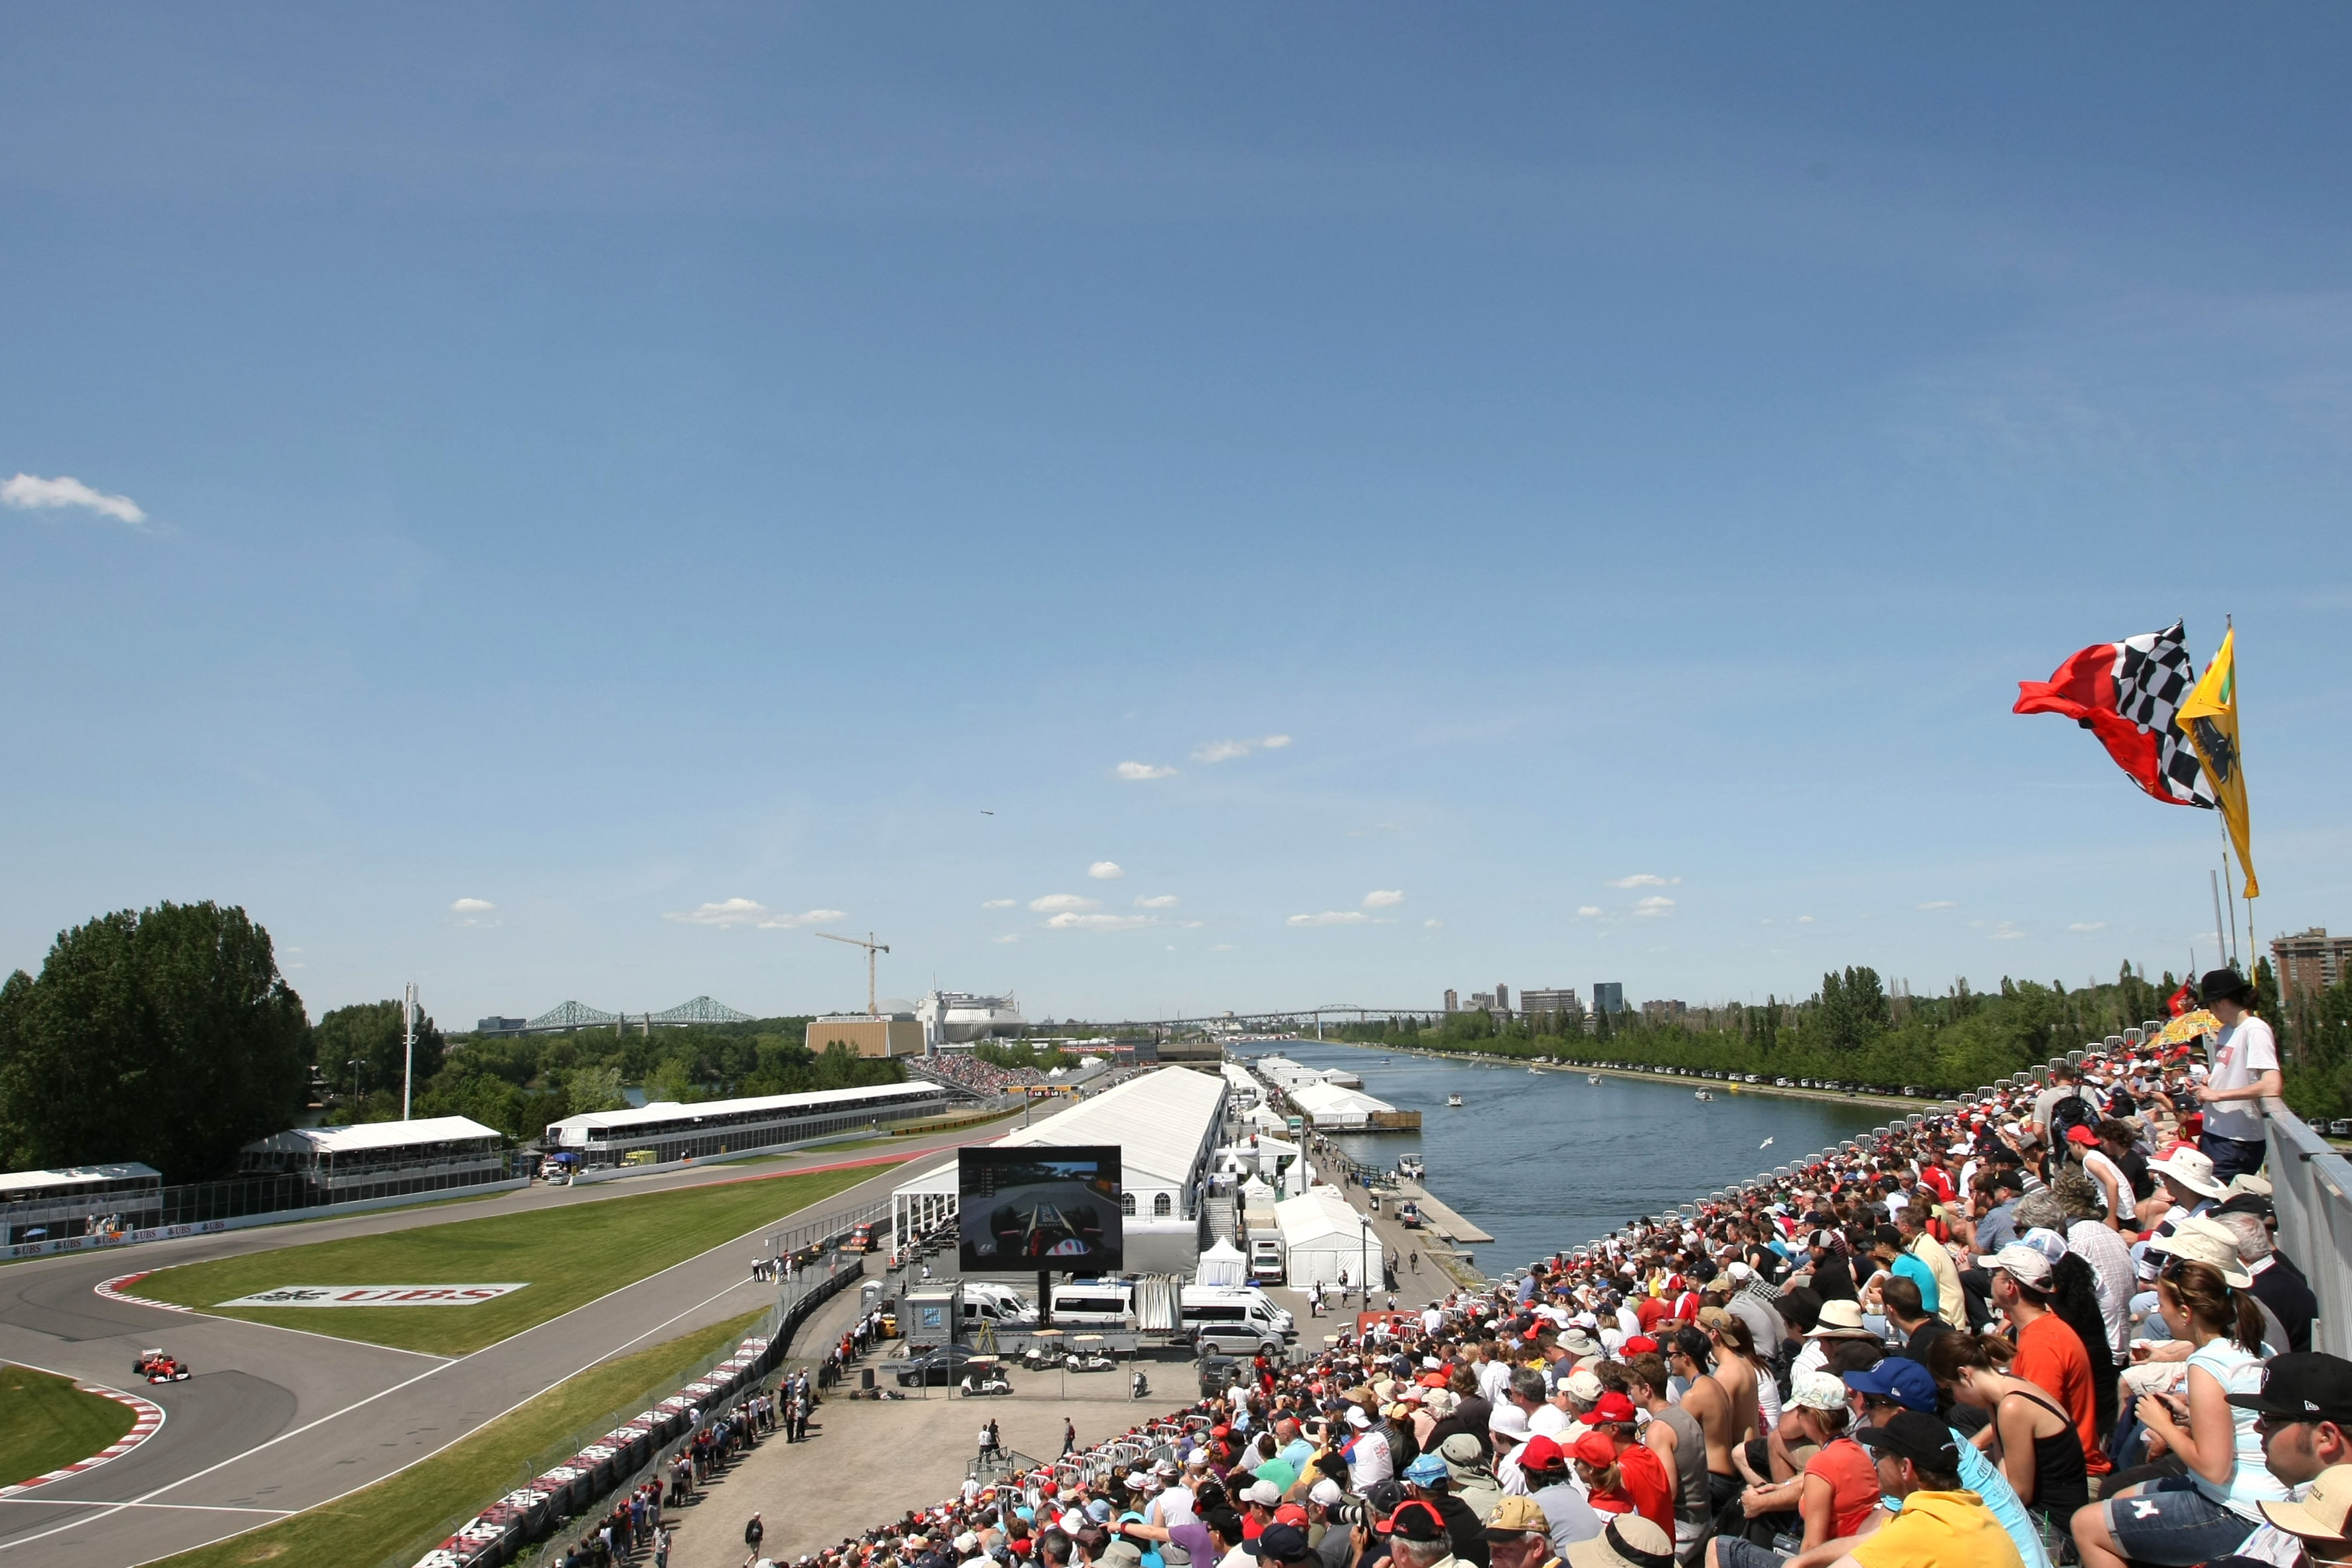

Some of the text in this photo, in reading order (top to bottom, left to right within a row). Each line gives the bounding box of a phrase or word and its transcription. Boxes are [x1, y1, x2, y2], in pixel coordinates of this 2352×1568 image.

[175, 1225, 191, 1234] UBS
[210, 1221, 225, 1229] UBS
[139, 1229, 156, 1239] UBS
[23, 1244, 41, 1254] UBS
[64, 1239, 82, 1249] UBS
[334, 1289, 505, 1302] UBS
